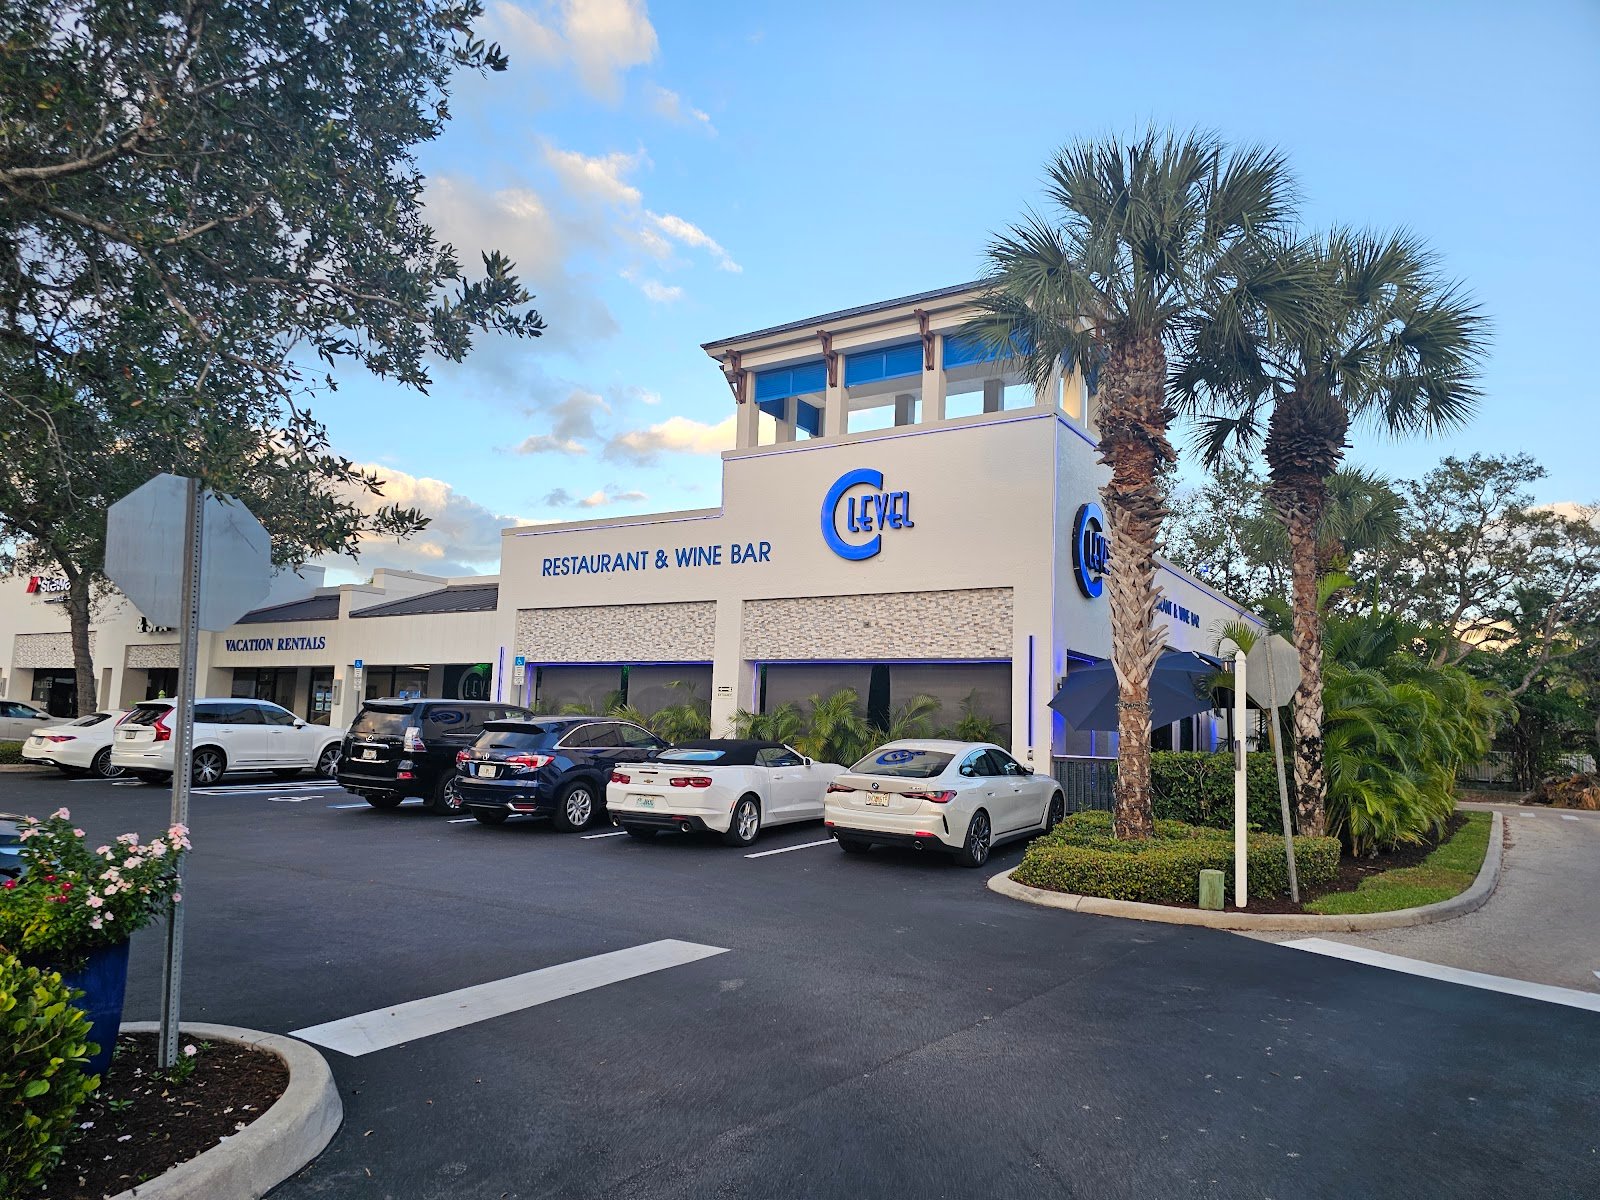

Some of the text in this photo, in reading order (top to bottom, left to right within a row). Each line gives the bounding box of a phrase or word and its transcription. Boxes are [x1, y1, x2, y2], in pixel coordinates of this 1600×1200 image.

[821, 468, 914, 561] C LEVEL
[542, 541, 772, 577] RESTAURANT & WINE BAR
[1072, 502, 1103, 598] C
[225, 636, 326, 652] VACATION RENTALS
